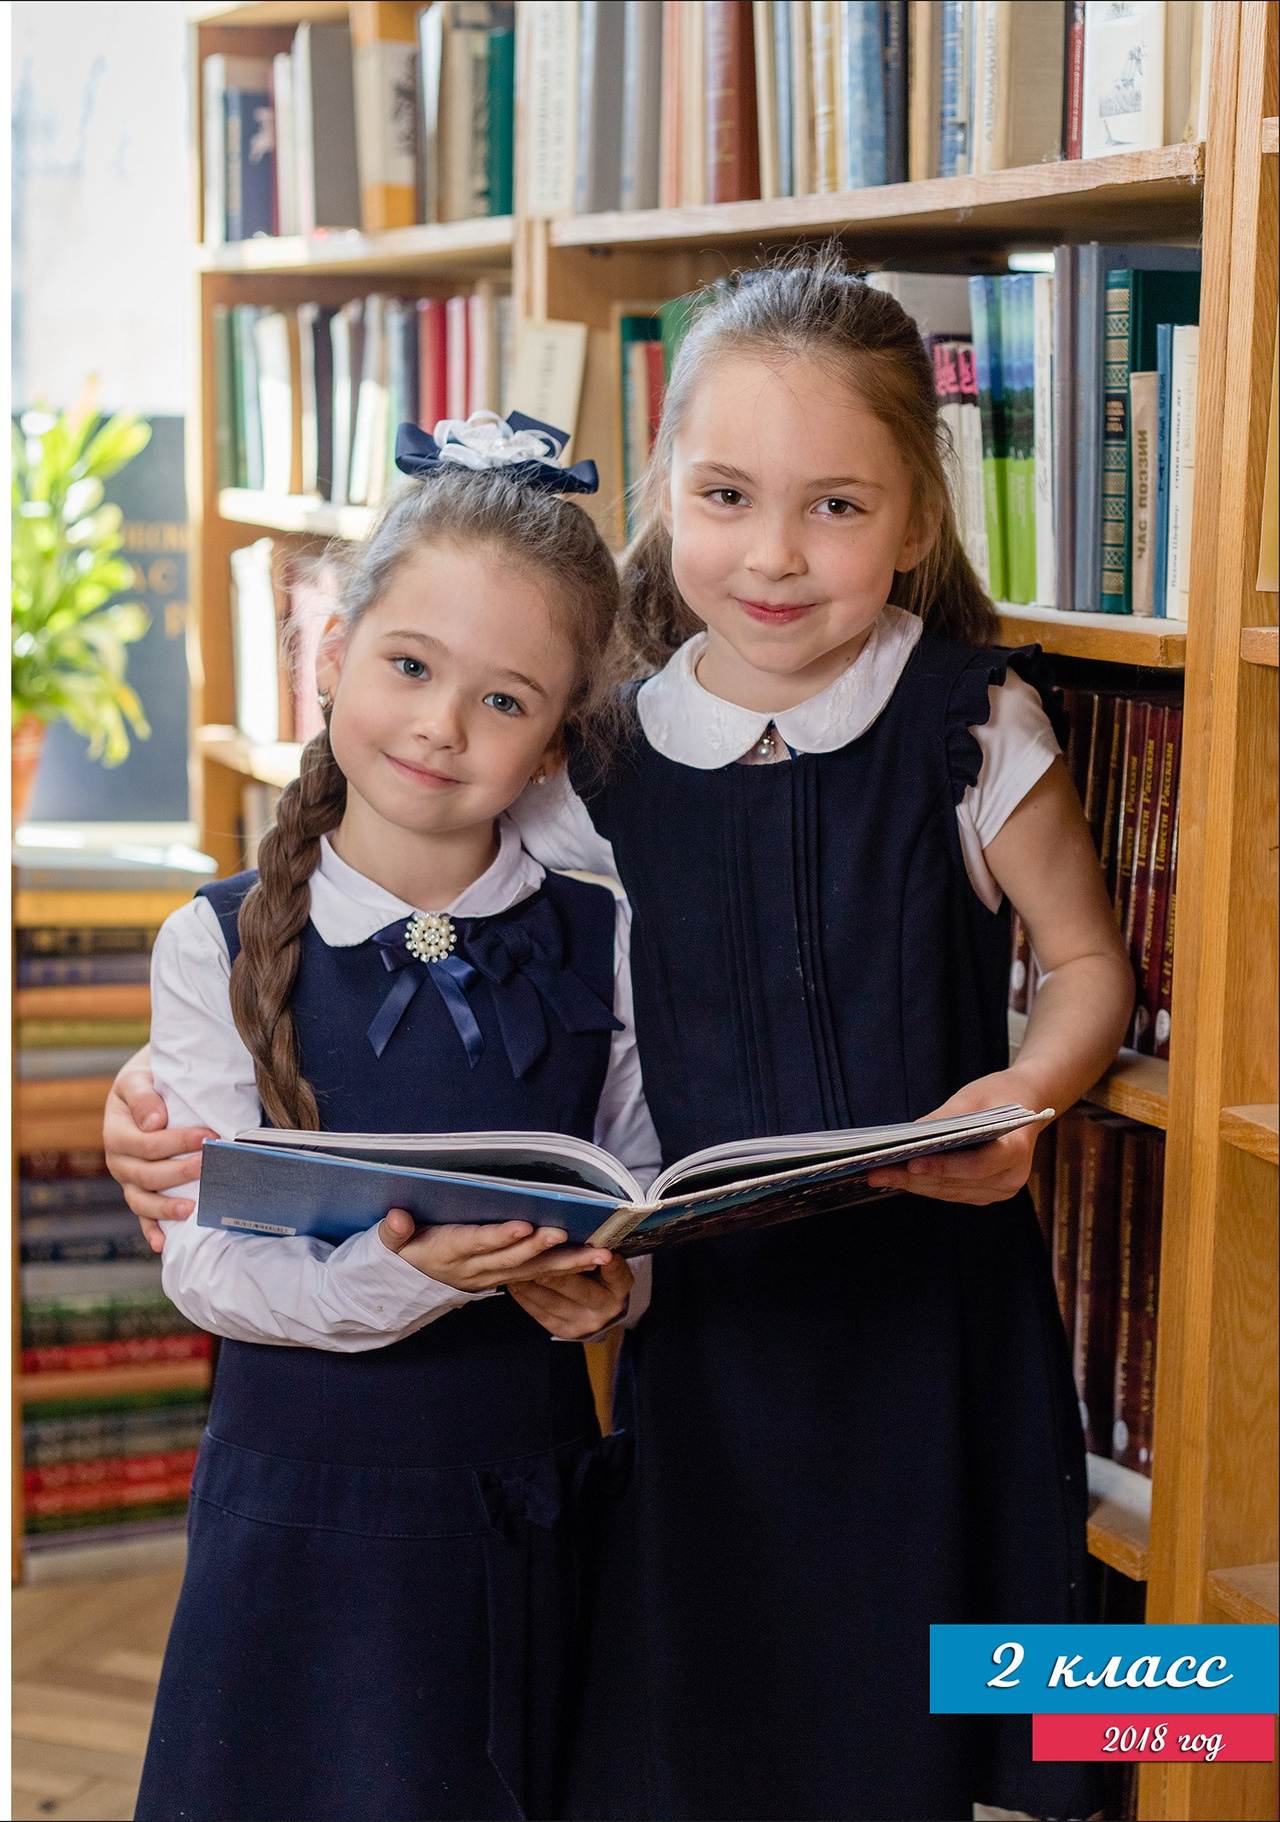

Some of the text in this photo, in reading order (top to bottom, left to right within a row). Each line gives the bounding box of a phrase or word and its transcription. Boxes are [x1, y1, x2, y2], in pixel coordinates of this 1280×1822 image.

[1136, 429, 1149, 559] ЧАС ПОЭЗИИ
[1142, 739, 1156, 804] Рассказы
[1161, 742, 1174, 808] Рассказы
[1137, 810, 1150, 867] Повести
[1155, 813, 1170, 871] Повести
